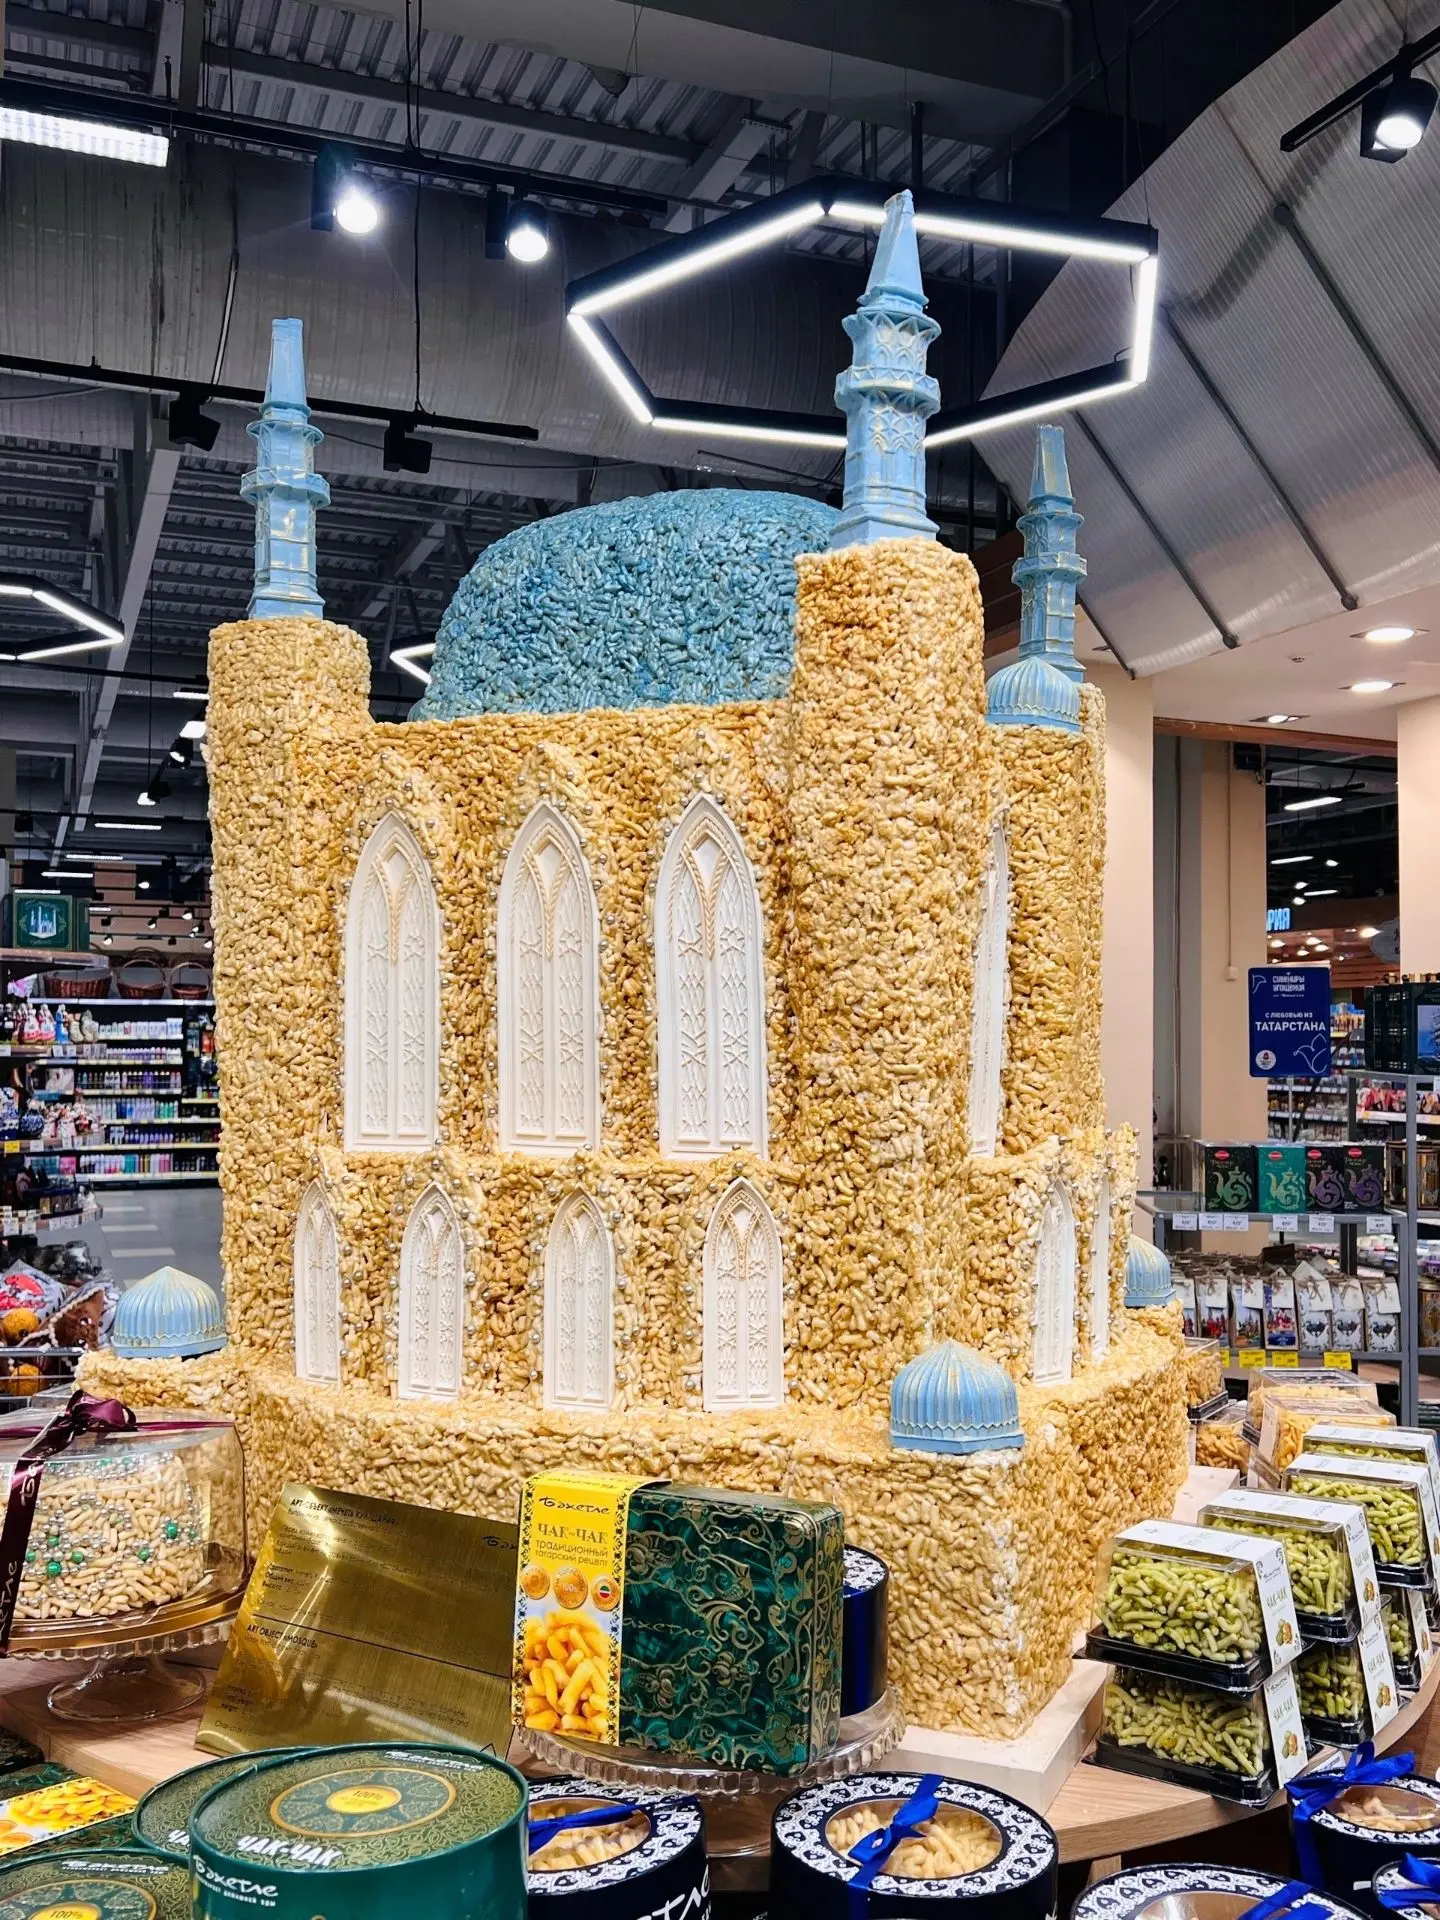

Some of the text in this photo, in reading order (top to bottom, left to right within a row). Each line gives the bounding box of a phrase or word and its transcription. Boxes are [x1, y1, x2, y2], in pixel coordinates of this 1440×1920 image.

[1267, 907, 1290, 931] РИЯ
[1255, 1021, 1326, 1031] ТАТАРСТАНА
[537, 1522, 608, 1545] ЧАК-ЧАК
[535, 1539, 609, 1558] традиционный
[535, 1549, 608, 1567] татарский рецепт
[247, 1624, 259, 1633] ART
[259, 1627, 283, 1639] OBJECT
[236, 1835, 343, 1867] ЧАК-ЧАК
